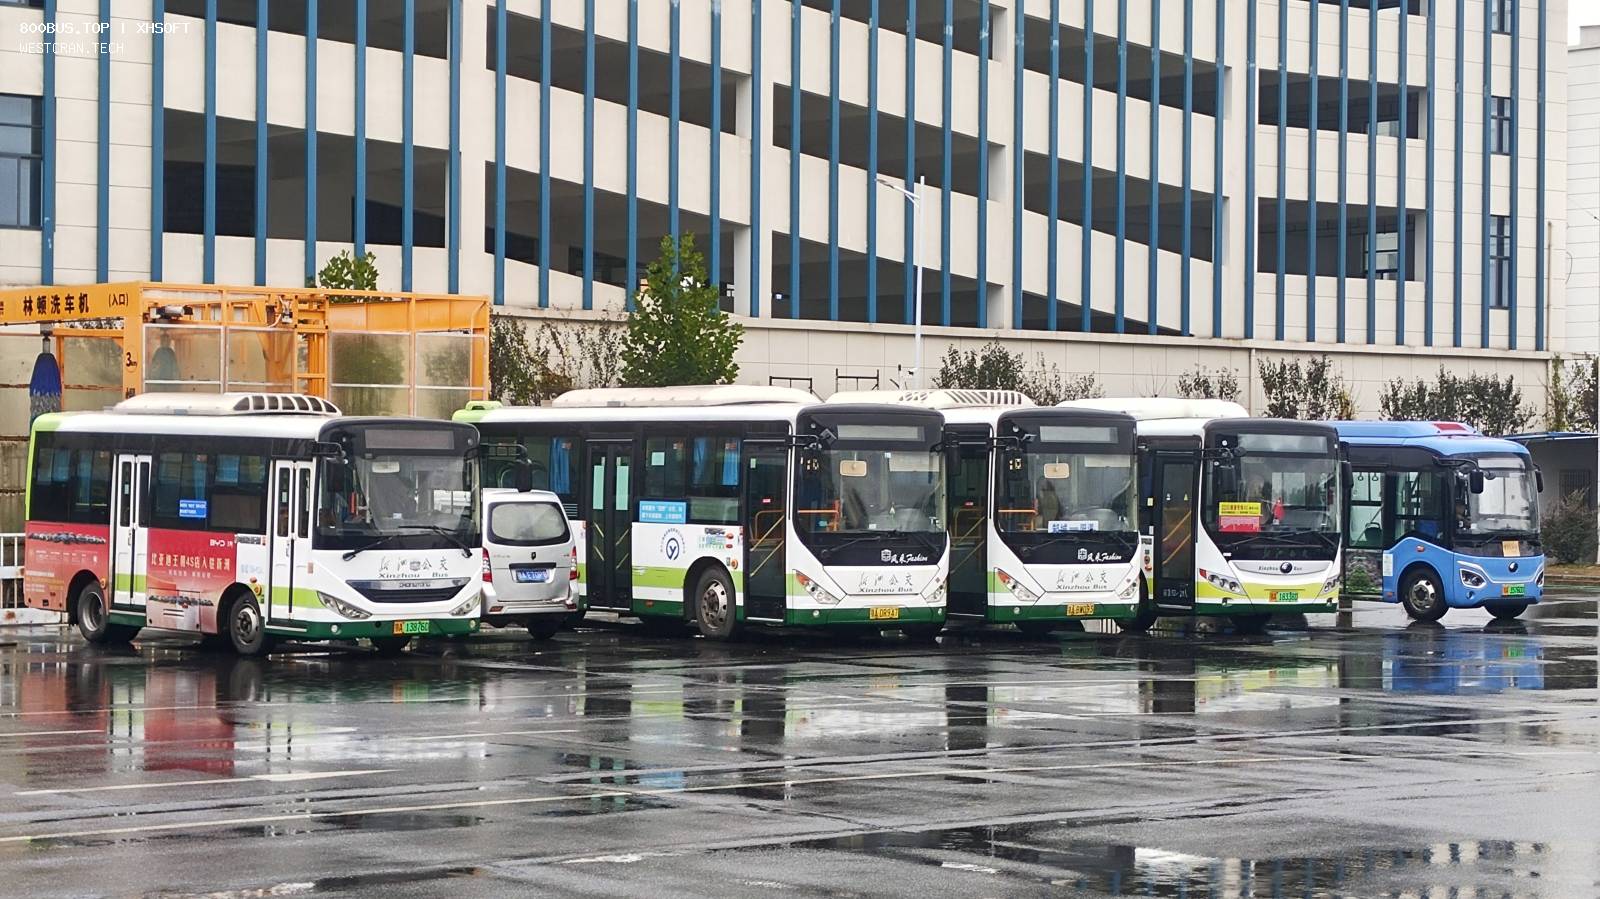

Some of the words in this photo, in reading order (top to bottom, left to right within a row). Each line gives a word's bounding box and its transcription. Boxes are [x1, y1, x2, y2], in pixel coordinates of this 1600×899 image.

[23, 292, 90, 316] 林顿洗车机
[209, 539, 226, 547] BYD
